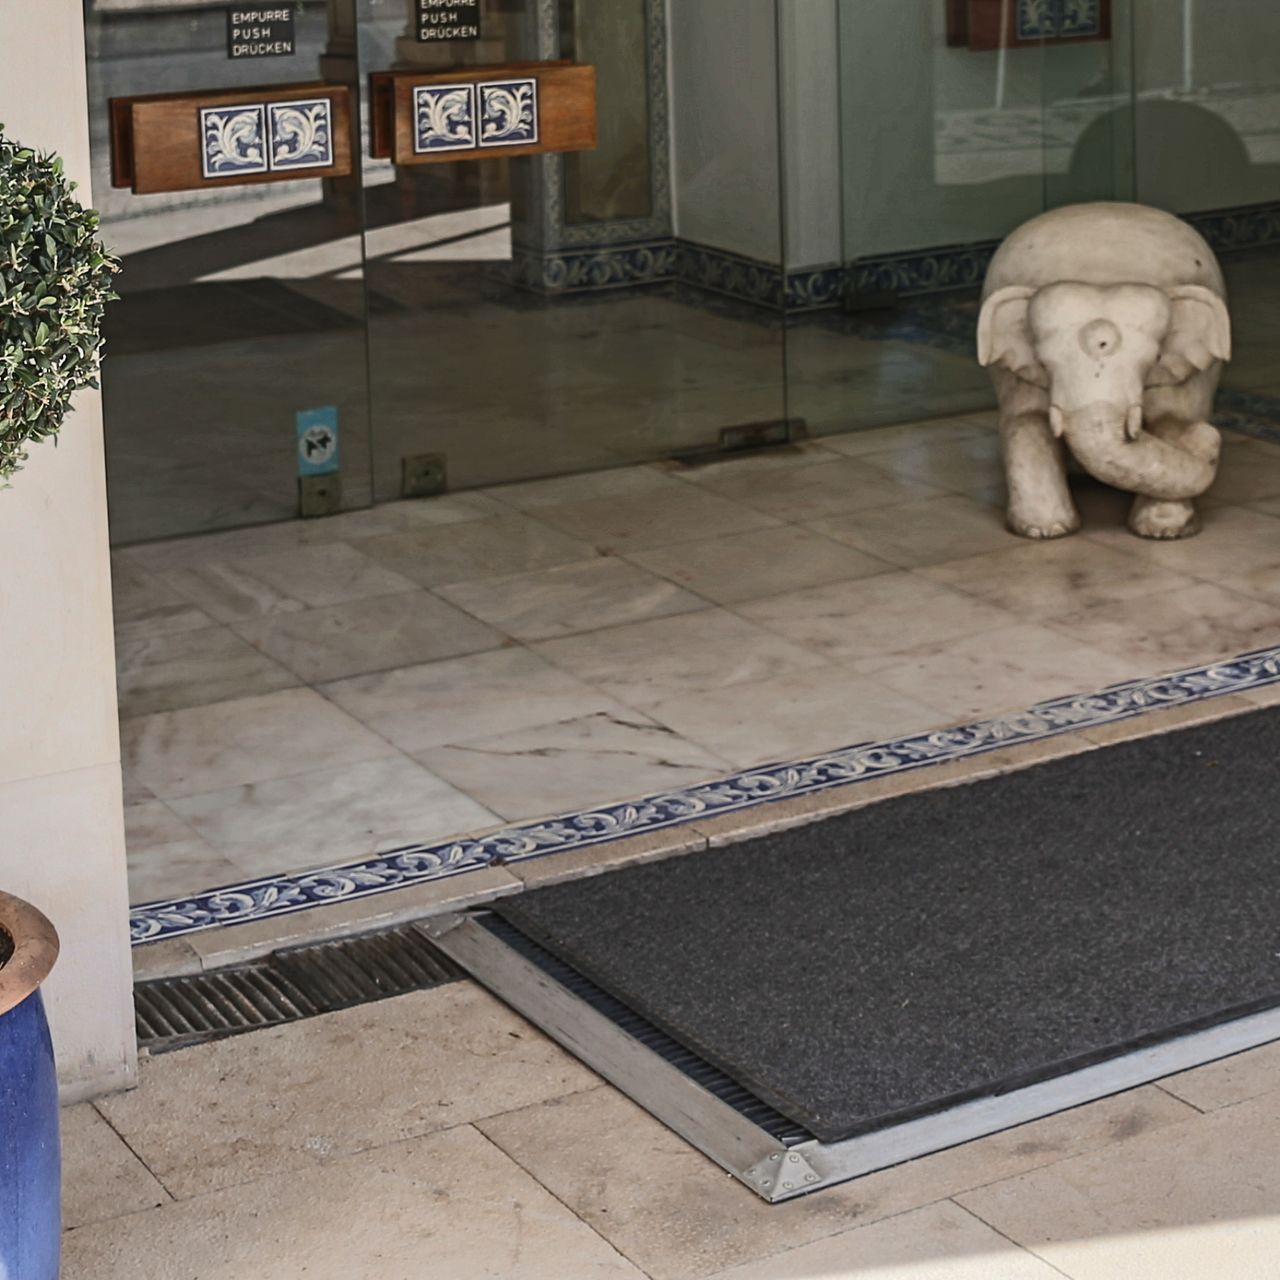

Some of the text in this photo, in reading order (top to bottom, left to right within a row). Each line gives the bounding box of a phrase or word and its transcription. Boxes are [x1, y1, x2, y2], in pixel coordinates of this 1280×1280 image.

[232, 9, 291, 25] EMPURRE
[421, 11, 458, 24] PUSH
[232, 27, 272, 40] PUSH
